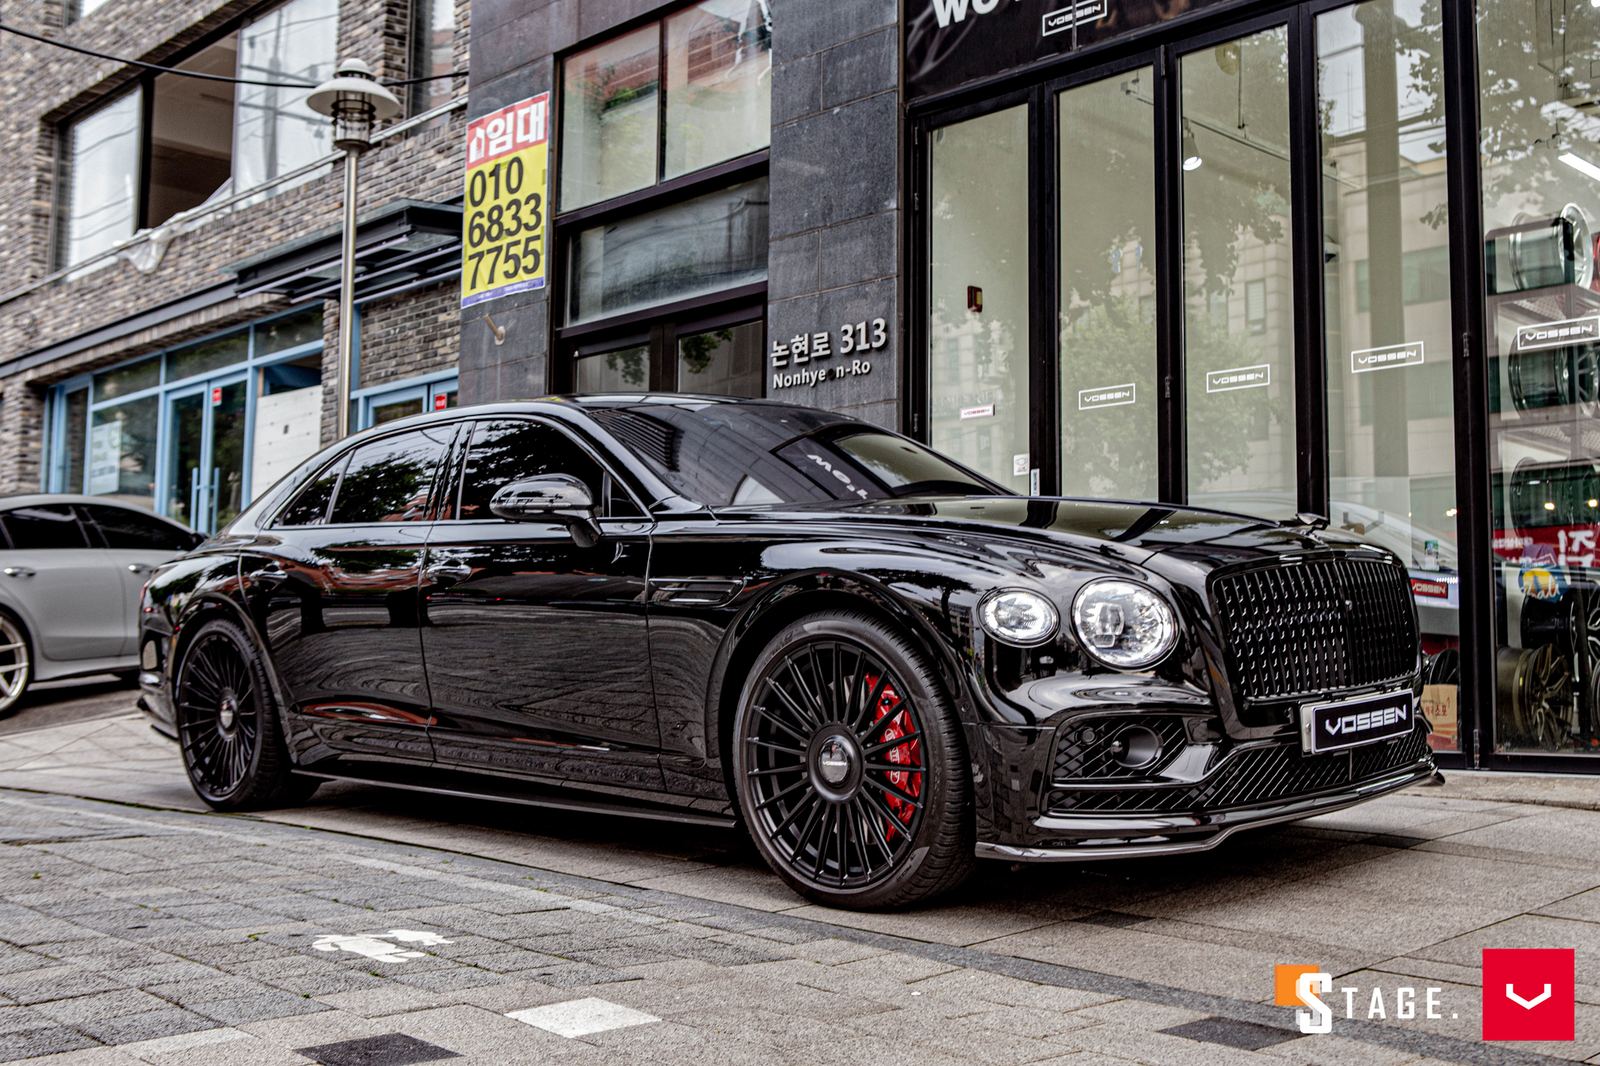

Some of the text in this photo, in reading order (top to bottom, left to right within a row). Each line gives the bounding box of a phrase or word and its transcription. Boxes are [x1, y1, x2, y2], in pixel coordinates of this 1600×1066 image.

[1048, 3, 1101, 27] VOSSEN
[469, 156, 524, 207] 010
[468, 192, 542, 248] 6833
[468, 234, 541, 290] 7755
[770, 317, 887, 367] 논현로 313
[1525, 324, 1593, 341] VOSSEN
[1358, 349, 1417, 365] VOSSEN
[1212, 371, 1264, 385] VOSSEN
[1084, 389, 1130, 403] VOSSEN
[1325, 704, 1407, 736] VOSSEN
